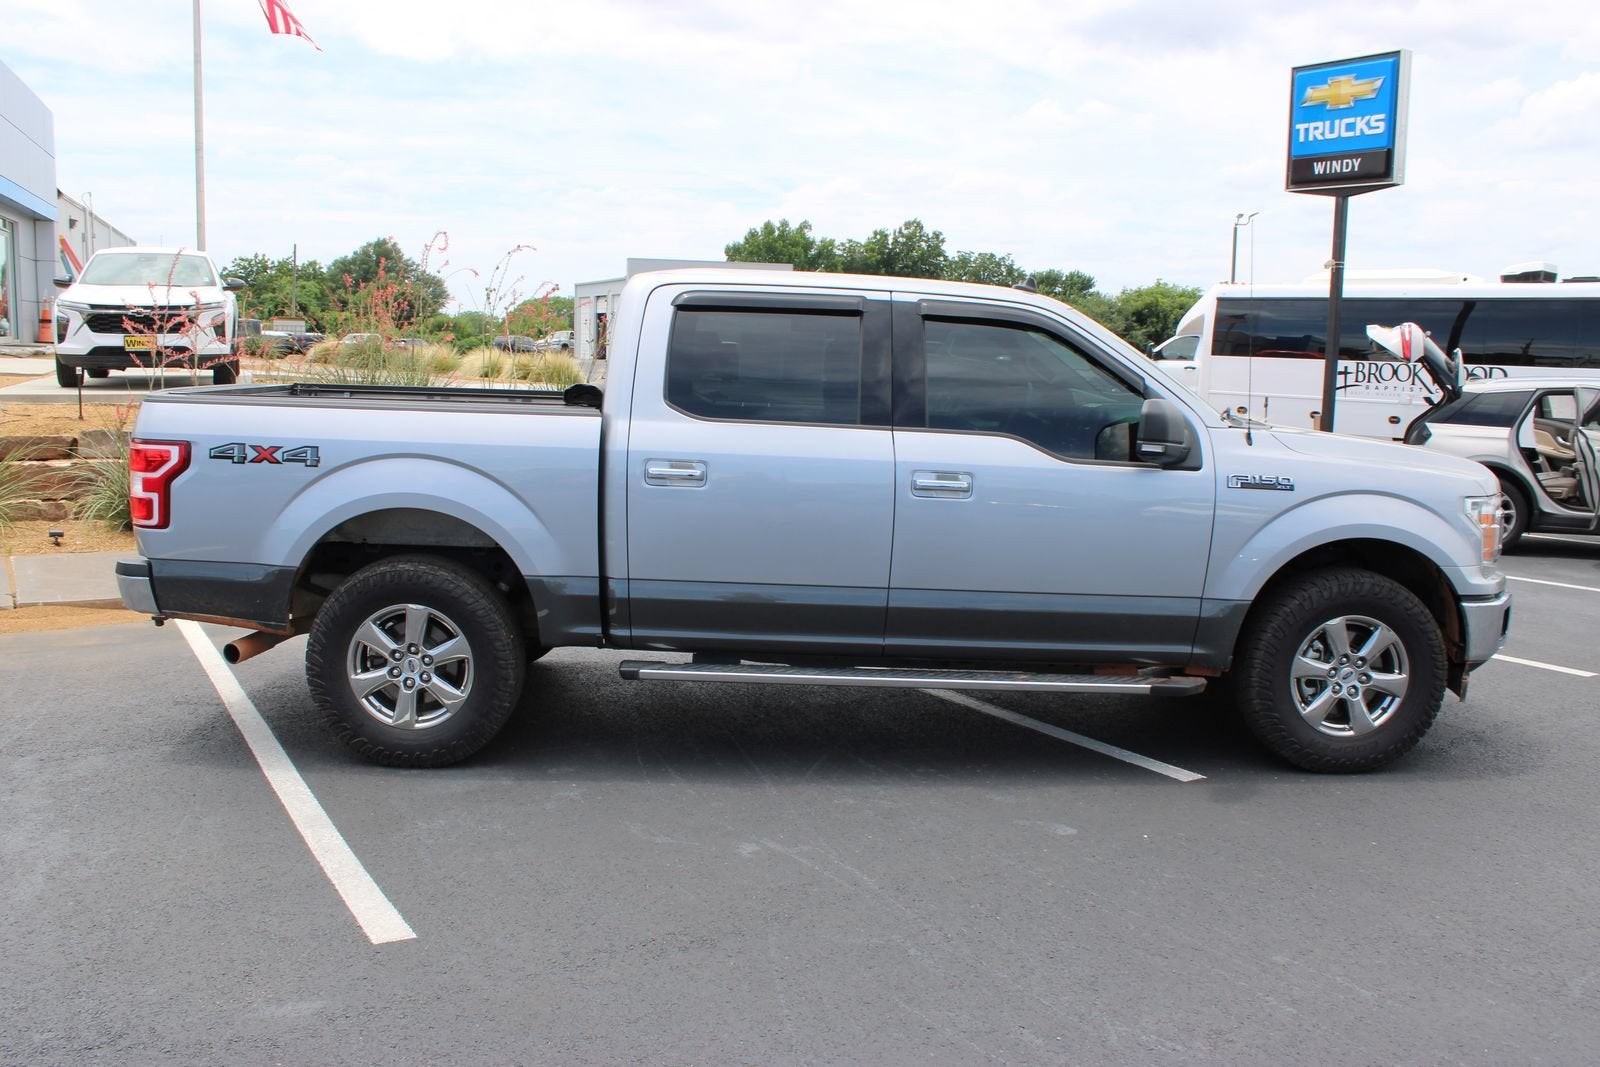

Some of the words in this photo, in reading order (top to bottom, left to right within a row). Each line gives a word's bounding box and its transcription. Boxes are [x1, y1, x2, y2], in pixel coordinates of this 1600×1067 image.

[1295, 113, 1386, 142] TRUCKS
[1313, 158, 1361, 175] WINDY
[1365, 385, 1424, 393] BAPTIST
